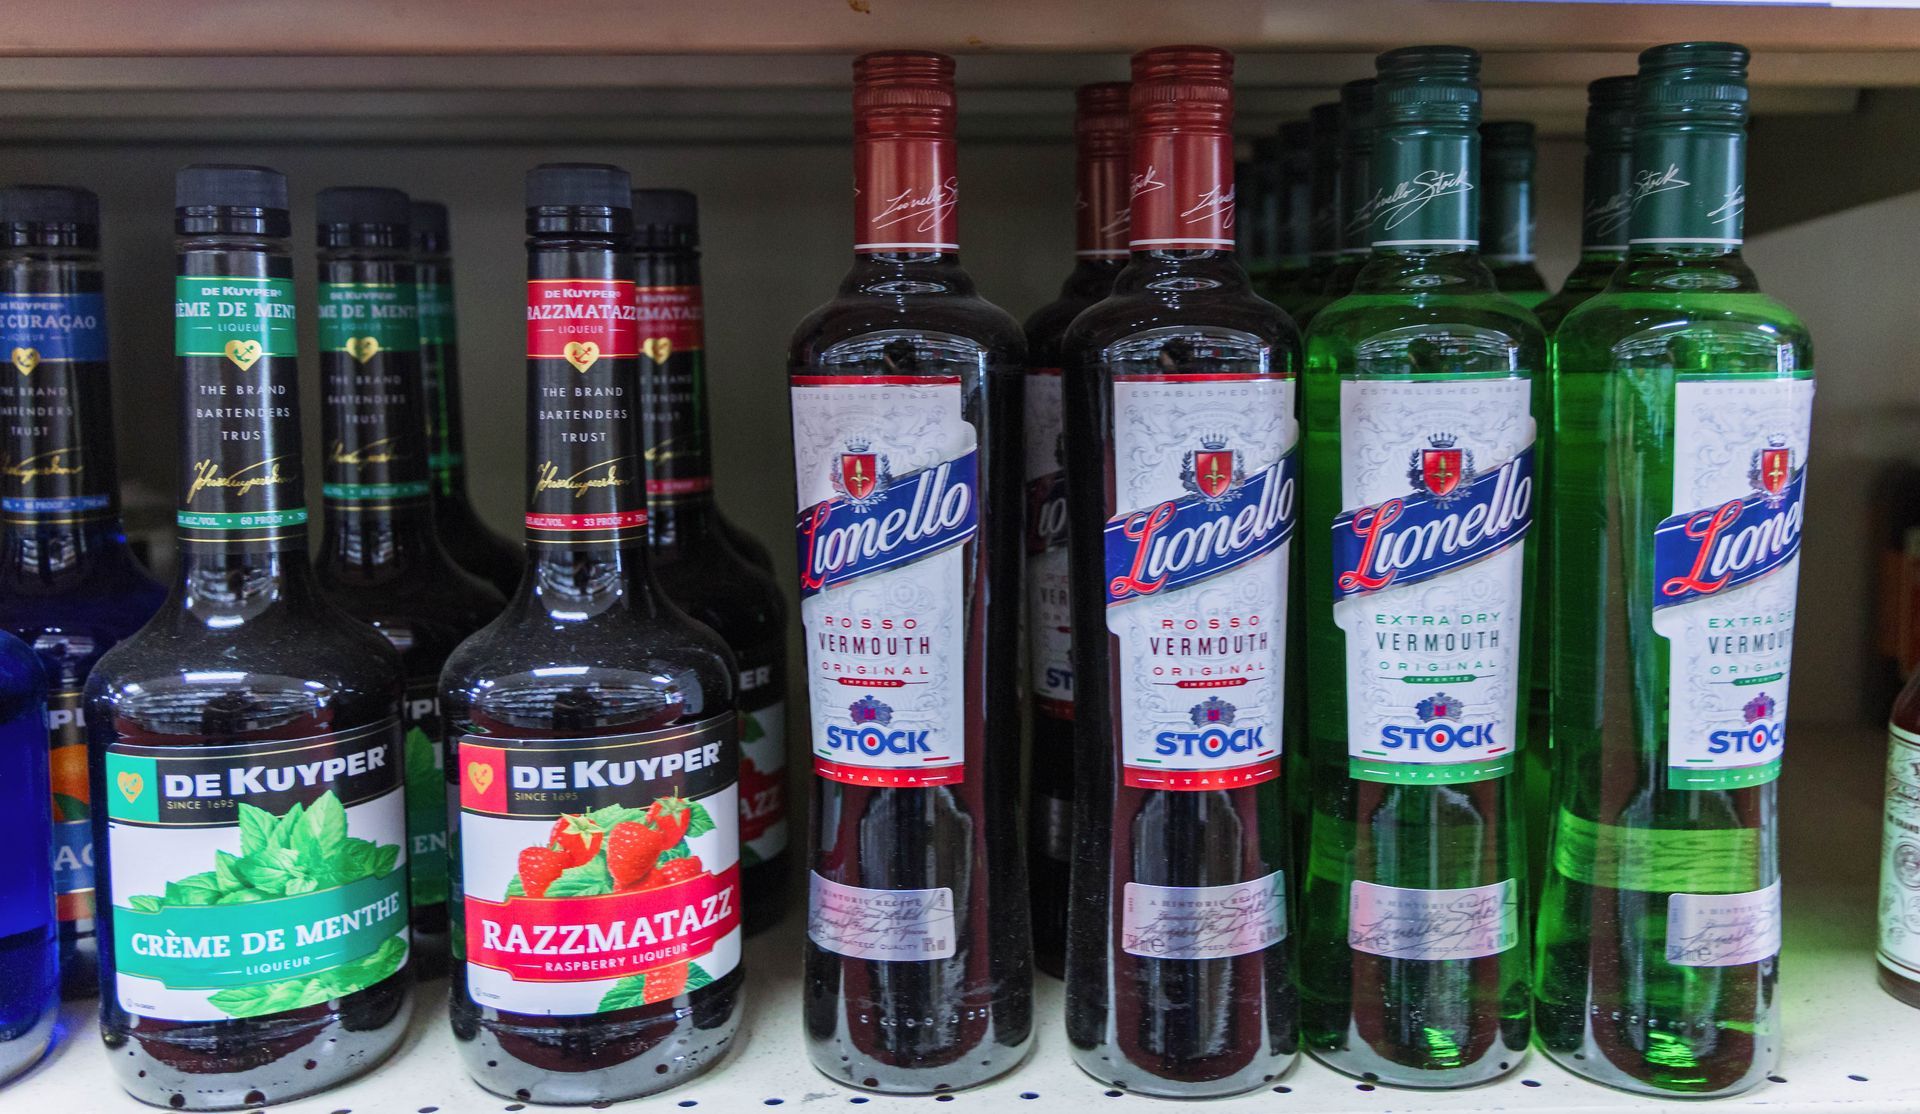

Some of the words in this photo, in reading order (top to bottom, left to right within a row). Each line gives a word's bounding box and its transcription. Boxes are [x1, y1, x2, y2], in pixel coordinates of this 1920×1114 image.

[201, 287, 220, 296] DE
[544, 290, 560, 298] DE
[563, 289, 616, 299] KUYPER
[218, 302, 247, 317] DE
[341, 304, 365, 318] DE
[7, 314, 96, 332] CURAÇAO
[558, 325, 604, 334] LIQUEUR
[200, 385, 226, 395] THE
[236, 385, 286, 395] BRAND
[542, 387, 566, 397] THE
[574, 387, 624, 397] BRAND
[196, 408, 290, 418] BARTENDERS
[539, 409, 628, 420] BARTENDERS
[11, 426, 48, 436] TRUST
[561, 432, 607, 443] TRUST
[801, 461, 971, 589] Lionello
[1110, 459, 1294, 597] Lionello
[1338, 458, 1532, 590] Lionello
[825, 616, 917, 629] ROSSO
[1162, 615, 1259, 630] ROSSO
[1376, 614, 1450, 625] EXTRA
[1461, 612, 1501, 625] DRY
[1709, 616, 1773, 628] EXTRA
[819, 632, 930, 655] VERMOUTH
[1150, 632, 1267, 656] VERMOUTH
[1376, 630, 1499, 651] VERMOUTH
[822, 662, 929, 674] ORIGINAL
[1153, 662, 1265, 676] ORIGINAL
[1378, 660, 1496, 671] ORIGINAL
[827, 726, 931, 756] STOCK
[1155, 726, 1264, 757] STOCK
[1381, 723, 1494, 752] STOCK
[165, 774, 221, 797] DE
[229, 747, 385, 795] KUYPER
[513, 766, 566, 789] DE
[574, 743, 720, 788] KUYPER
[837, 772, 916, 783] ITALIA
[1170, 774, 1252, 785] ITALIA
[1395, 769, 1480, 778] ITALIA
[514, 792, 547, 801] SINCE
[552, 791, 578, 801] 1695
[167, 800, 200, 810] SINCE
[207, 799, 234, 809] 1695
[131, 929, 231, 958] CRÈME
[241, 929, 285, 955] DE
[295, 892, 399, 947] MENTHE
[482, 889, 732, 954] RAZZMATAZZ
[545, 956, 627, 972] RASPBERRY
[633, 942, 688, 964] LIQUEUR
[246, 956, 311, 976] LIQUEUR
